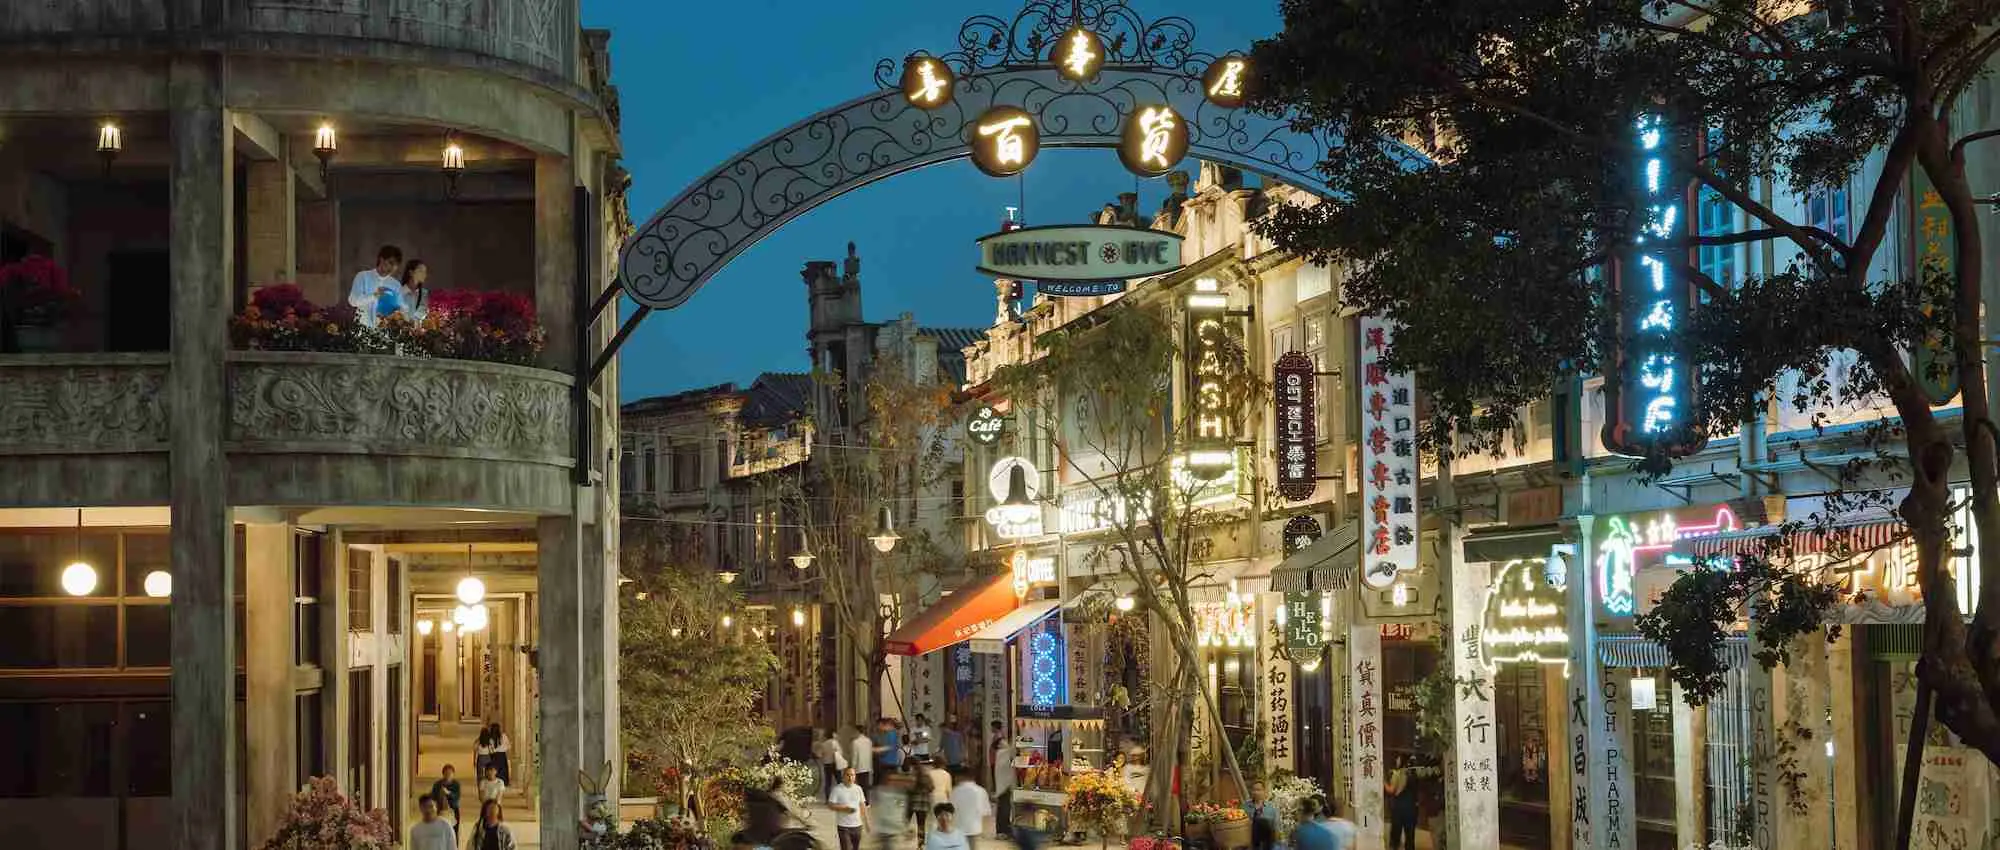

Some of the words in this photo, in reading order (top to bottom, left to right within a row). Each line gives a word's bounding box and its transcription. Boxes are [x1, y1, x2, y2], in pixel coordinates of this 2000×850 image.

[1047, 284, 1099, 294] WELCOME
[1105, 283, 1120, 292] TO
[1199, 320, 1222, 437] CASH
[1286, 374, 1301, 403] GET
[969, 418, 1002, 432] Café
[1287, 406, 1303, 442] RICH
[1294, 601, 1318, 646] HELLO
[1607, 750, 1620, 848] PHARMA
